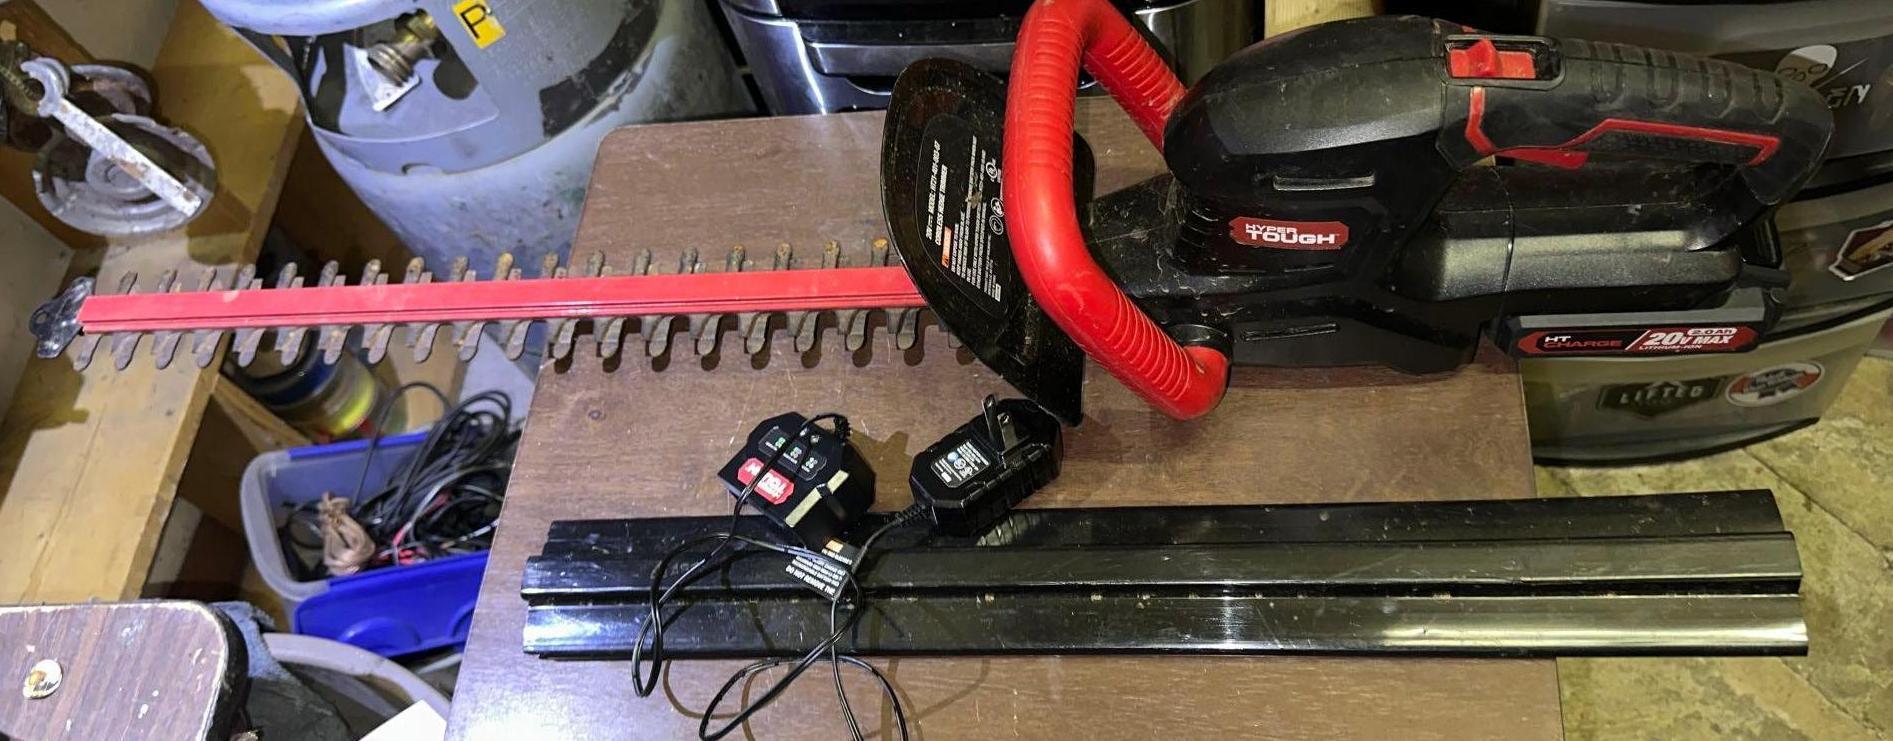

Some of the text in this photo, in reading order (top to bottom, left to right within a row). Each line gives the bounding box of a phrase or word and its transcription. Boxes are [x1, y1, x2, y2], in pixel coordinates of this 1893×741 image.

[460, 4, 487, 39] P
[935, 211, 944, 245] CORDLESS
[1245, 224, 1297, 234] HYPER
[1246, 230, 1335, 244] TOUGH
[1544, 340, 1622, 348] CHARGE
[1692, 335, 1734, 345] MAX
[1620, 386, 1704, 404] LIFTED
